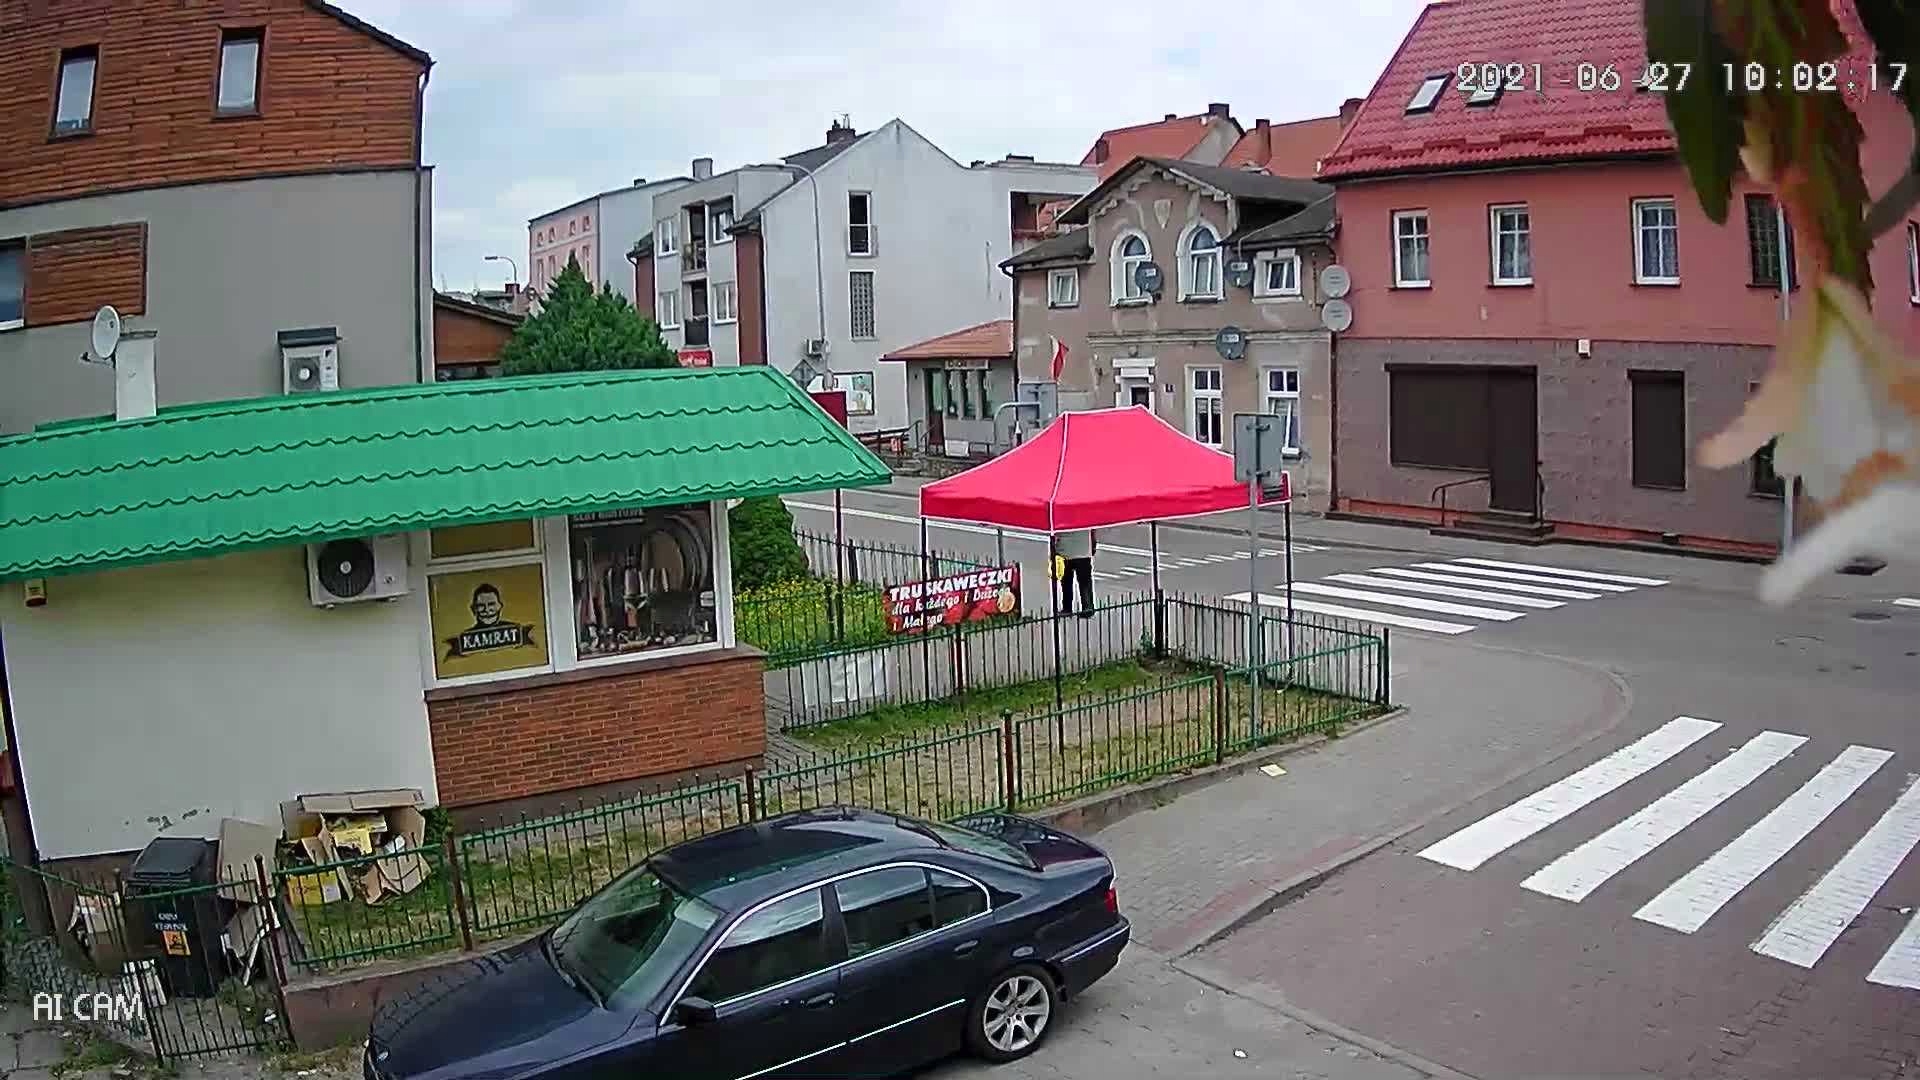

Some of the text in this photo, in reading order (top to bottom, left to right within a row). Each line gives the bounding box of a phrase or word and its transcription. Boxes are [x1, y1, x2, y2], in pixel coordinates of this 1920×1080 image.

[889, 568, 1013, 602] TRUSKAWECZKI
[892, 602, 910, 616] dla
[463, 628, 518, 649] KAMRAT
